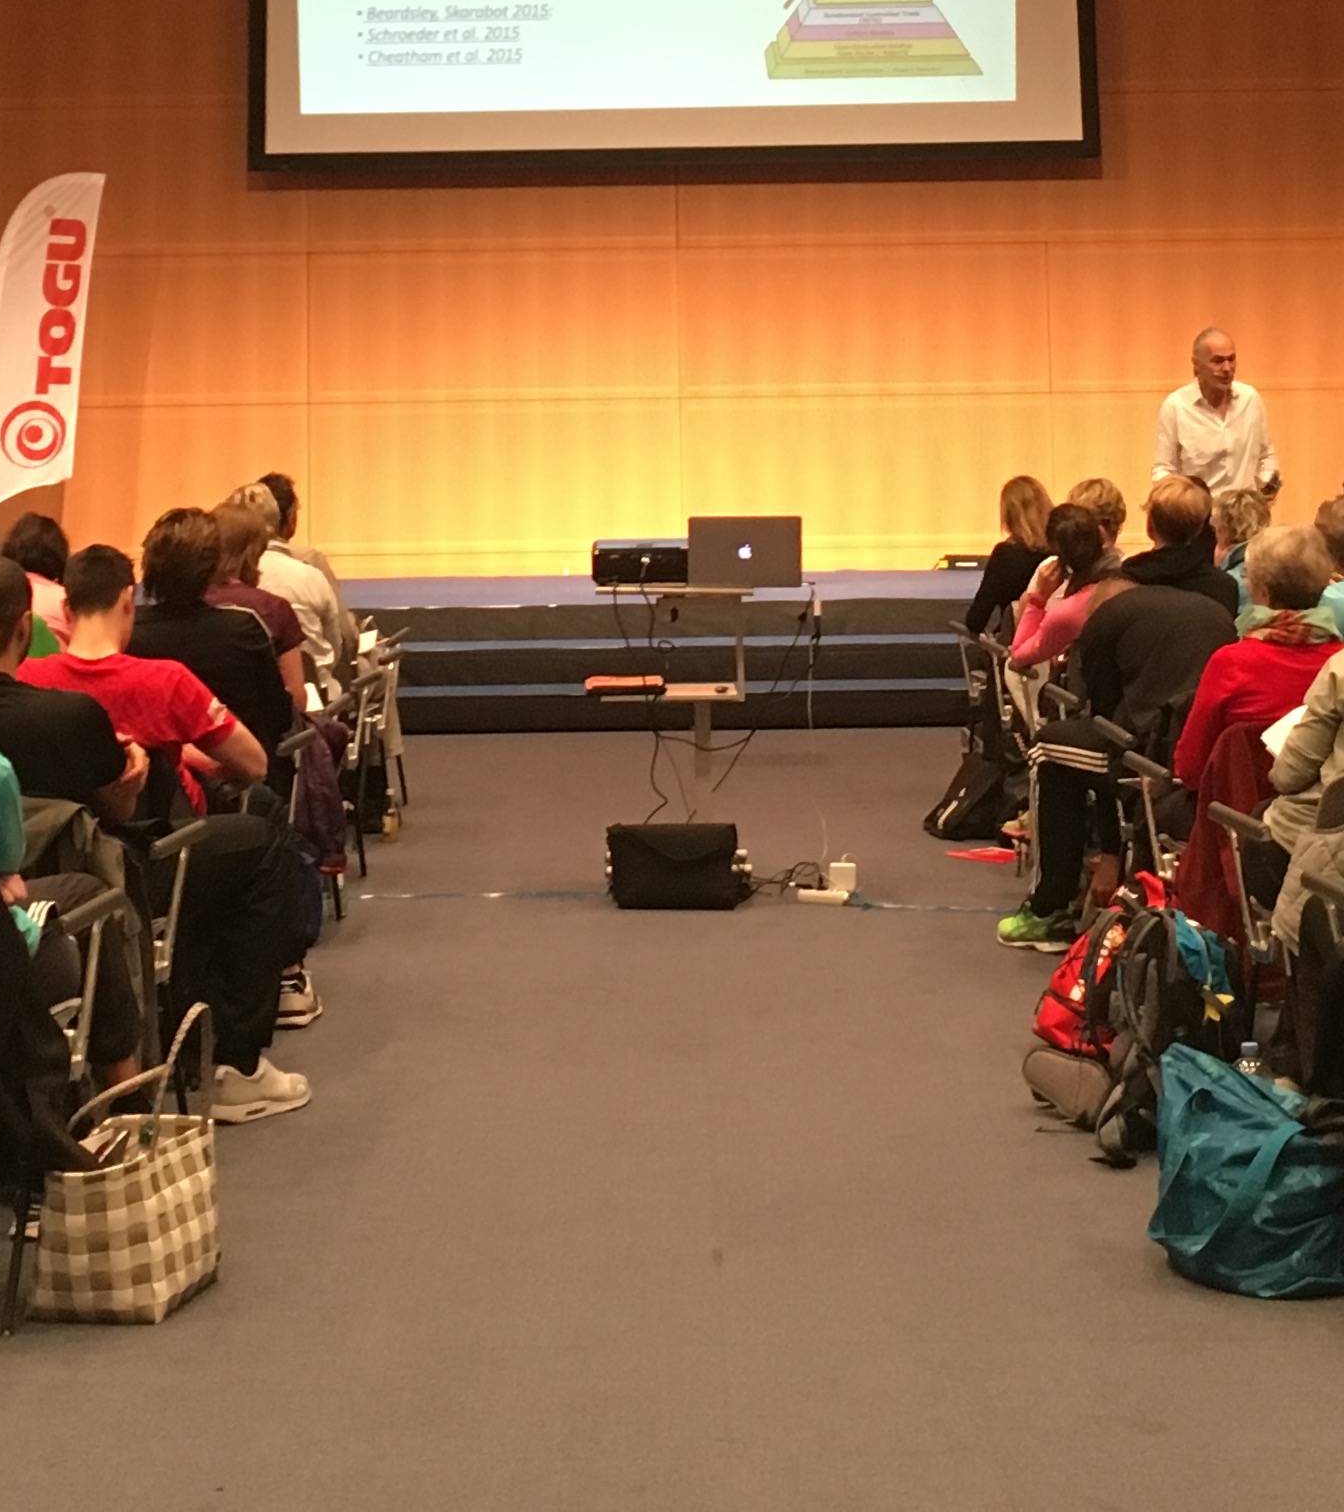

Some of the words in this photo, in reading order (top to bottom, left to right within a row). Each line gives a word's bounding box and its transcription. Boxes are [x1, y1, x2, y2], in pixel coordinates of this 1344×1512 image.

[367, 27, 440, 43] Schroeder
[444, 27, 458, 41] et
[485, 25, 520, 41] 2015
[368, 49, 443, 64] Cheatham
[446, 49, 461, 63] et
[487, 47, 523, 62] 2015
[35, 218, 87, 395] TOGU
